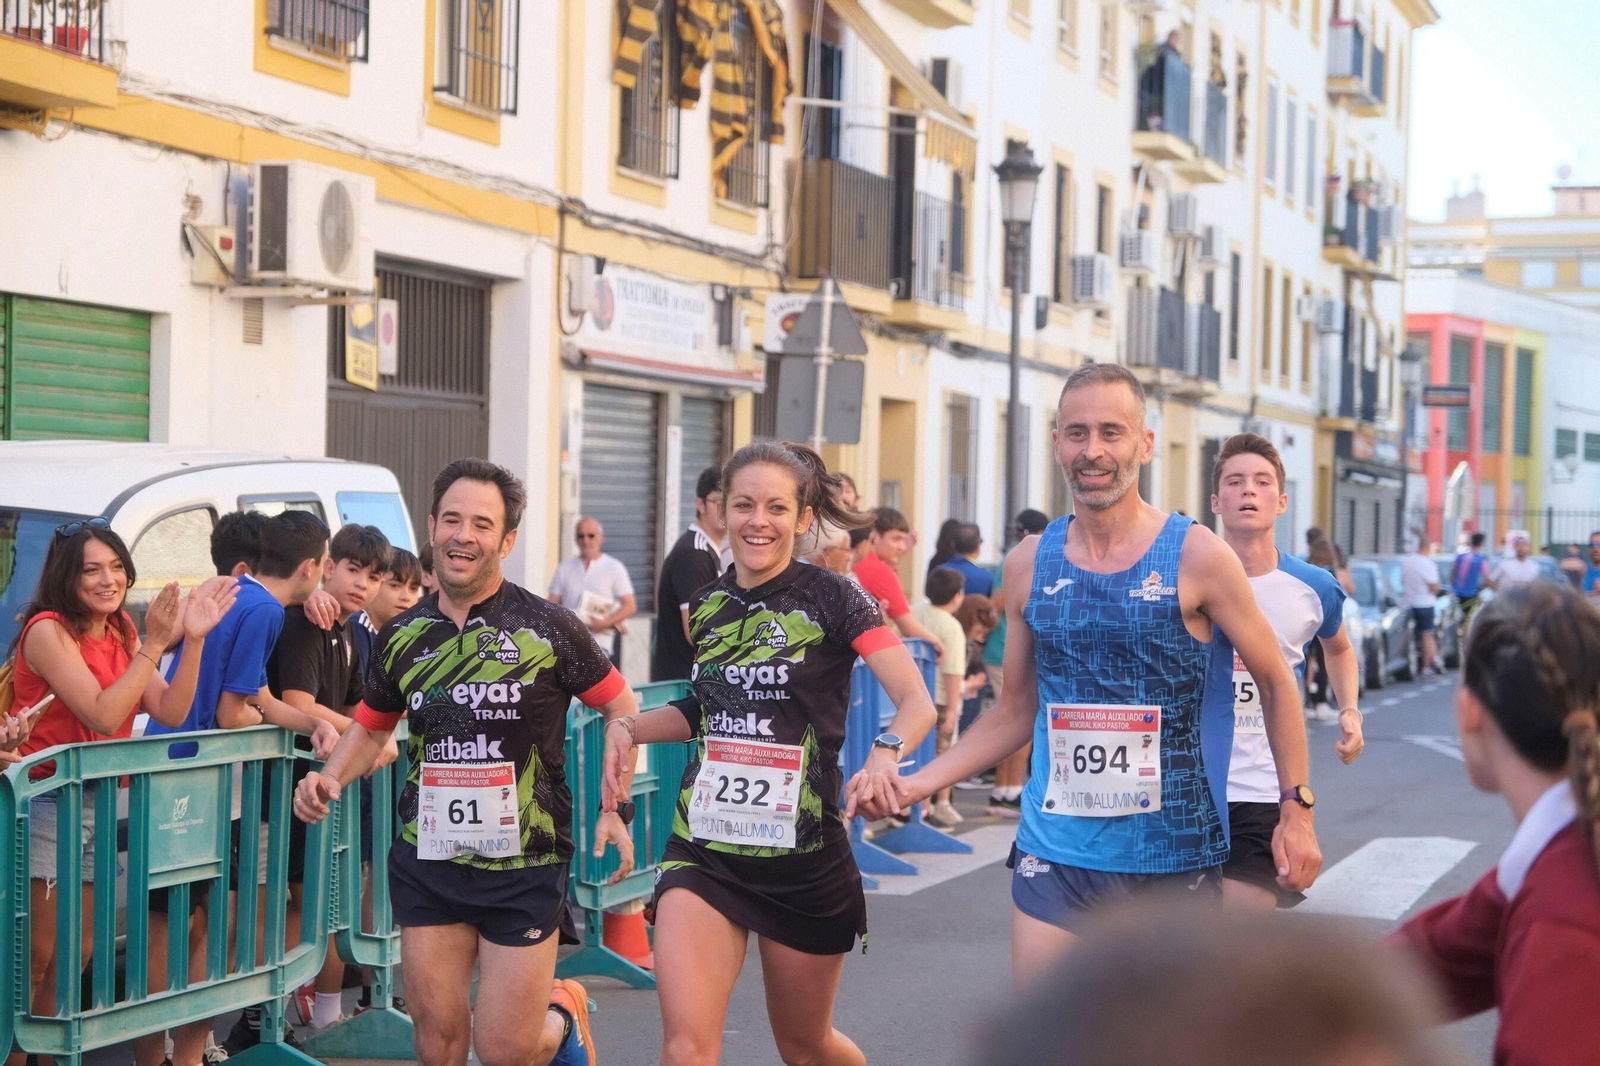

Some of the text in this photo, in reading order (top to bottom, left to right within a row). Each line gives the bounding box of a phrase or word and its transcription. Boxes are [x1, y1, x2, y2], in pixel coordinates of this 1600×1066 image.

[616, 277, 668, 308] TRATTORIA
[746, 690, 790, 700] TRAIL
[473, 709, 521, 721] TRAIL
[1060, 711, 1084, 720] CARRERA
[1086, 710, 1106, 721] MARÍA
[1069, 721, 1092, 729] MEMORIAL
[1093, 721, 1106, 729] KIKO
[715, 744, 734, 753] CARRERA
[735, 746, 752, 756] MARÍA
[1073, 744, 1130, 774] 694
[430, 770, 453, 778] CARRERA
[454, 769, 470, 778] MARÍA
[715, 775, 771, 807] 232
[448, 799, 483, 825] 61
